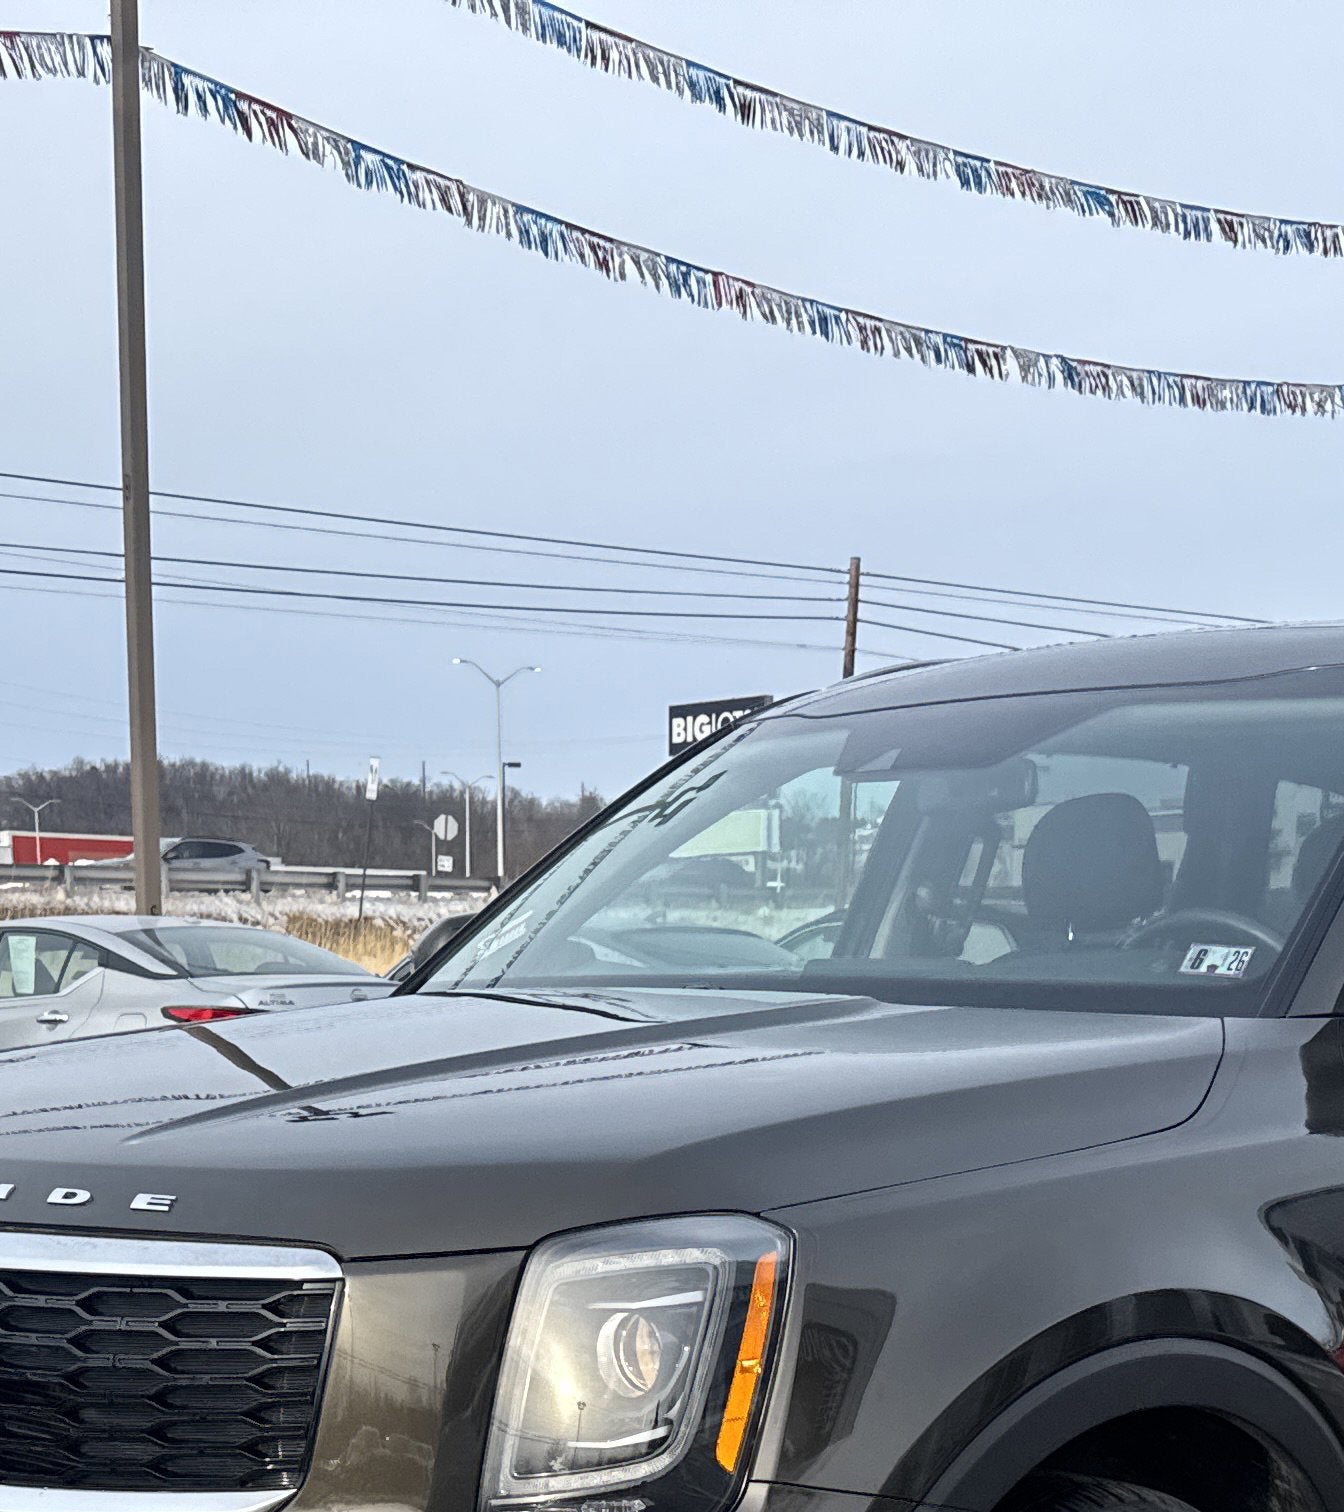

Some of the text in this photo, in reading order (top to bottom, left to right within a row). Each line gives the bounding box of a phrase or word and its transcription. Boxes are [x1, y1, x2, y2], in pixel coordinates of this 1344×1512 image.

[672, 713, 712, 744] BIG
[1190, 949, 1249, 972] 6 26
